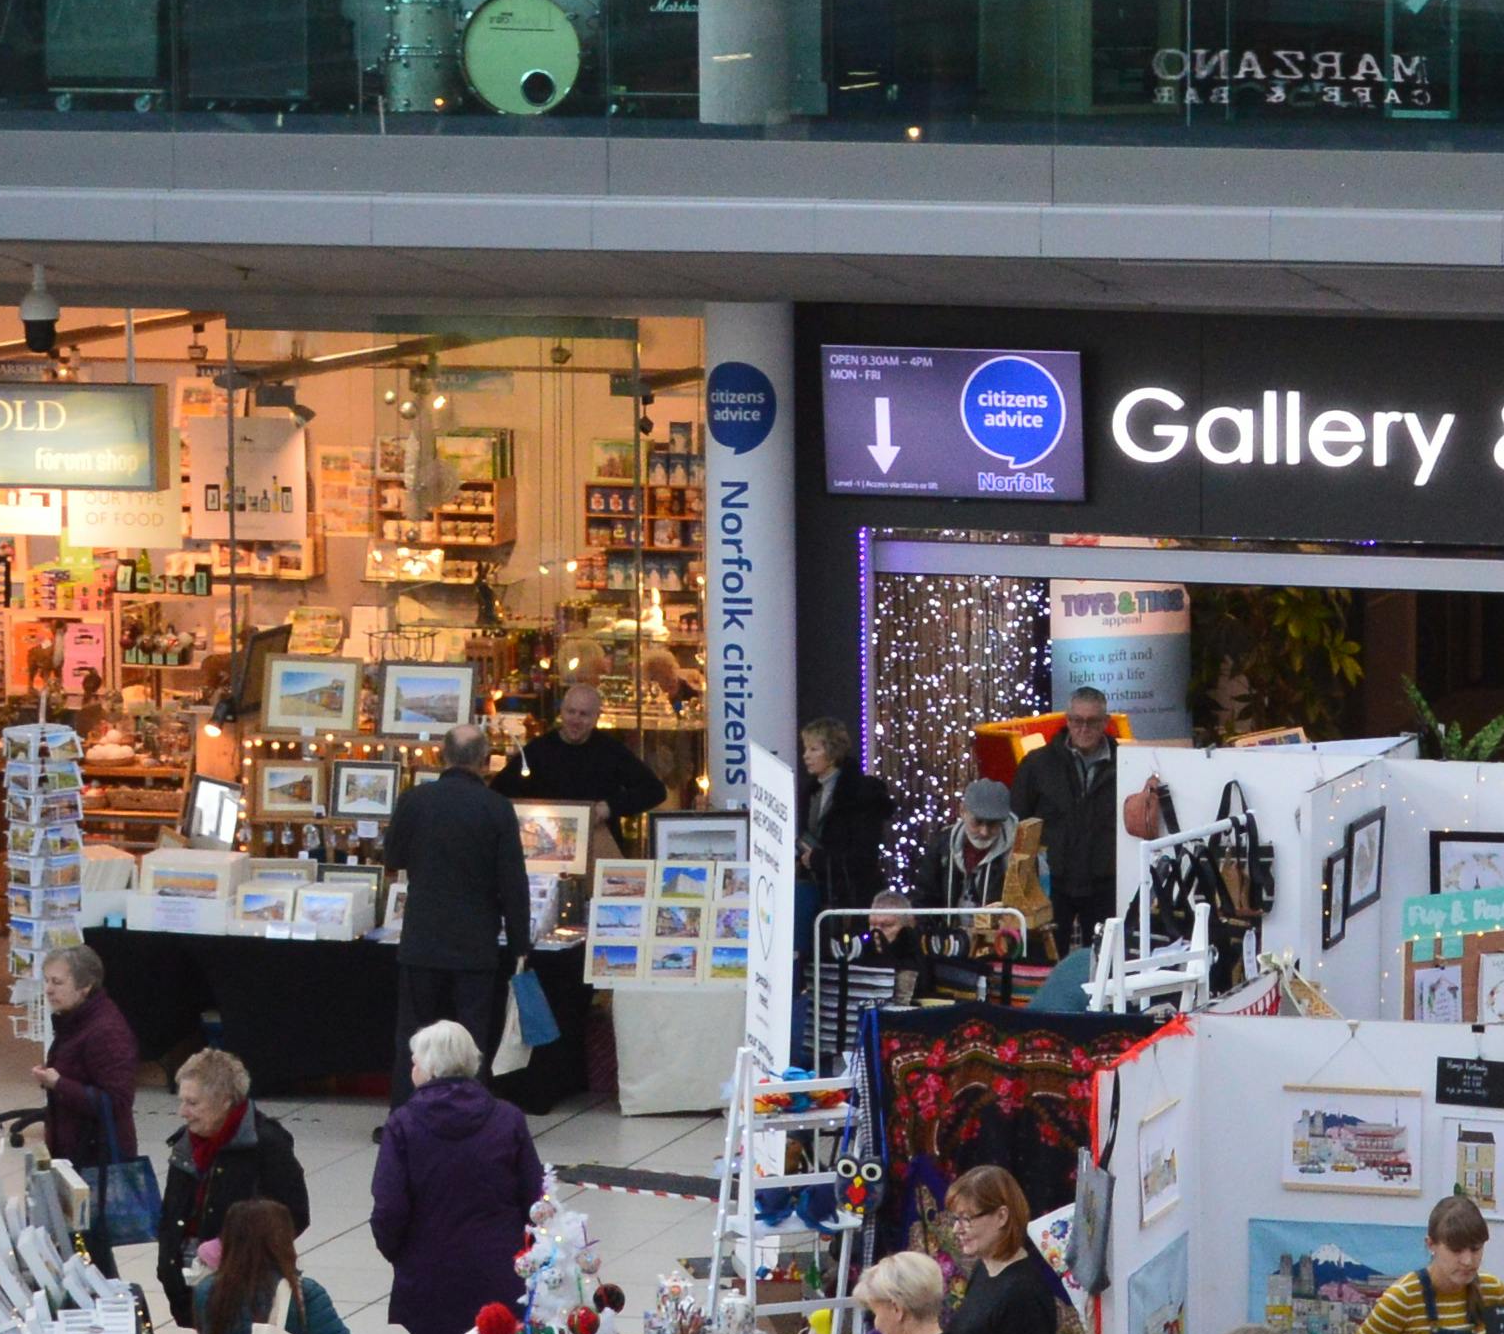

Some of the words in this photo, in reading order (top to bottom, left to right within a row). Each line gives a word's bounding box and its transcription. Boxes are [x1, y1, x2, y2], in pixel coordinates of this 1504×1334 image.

[830, 355, 858, 366] OPEN
[860, 355, 899, 367] 9.30AM
[910, 356, 933, 367] 4PM
[830, 369, 857, 380] MON
[865, 370, 881, 380] FRI
[710, 389, 765, 404] citizens
[978, 390, 1048, 409] citizens
[714, 407, 760, 422] advice
[983, 410, 1044, 428] advice
[1111, 386, 1455, 485] Gallery
[95, 452, 138, 476] shop
[978, 472, 1054, 493] Norfolk
[124, 491, 164, 506] TYPE
[86, 513, 106, 527] OF
[112, 513, 164, 528] FOOD
[721, 480, 753, 631] Norfolk
[1102, 615, 1142, 627] appeal
[1069, 651, 1095, 663] Give
[1108, 649, 1127, 663] gift
[1131, 648, 1152, 660] and
[1069, 671, 1096, 685] light
[1099, 672, 1114, 684] up
[1127, 669, 1145, 680] life
[1103, 688, 1154, 701] hristmas
[722, 642, 753, 786] citizens
